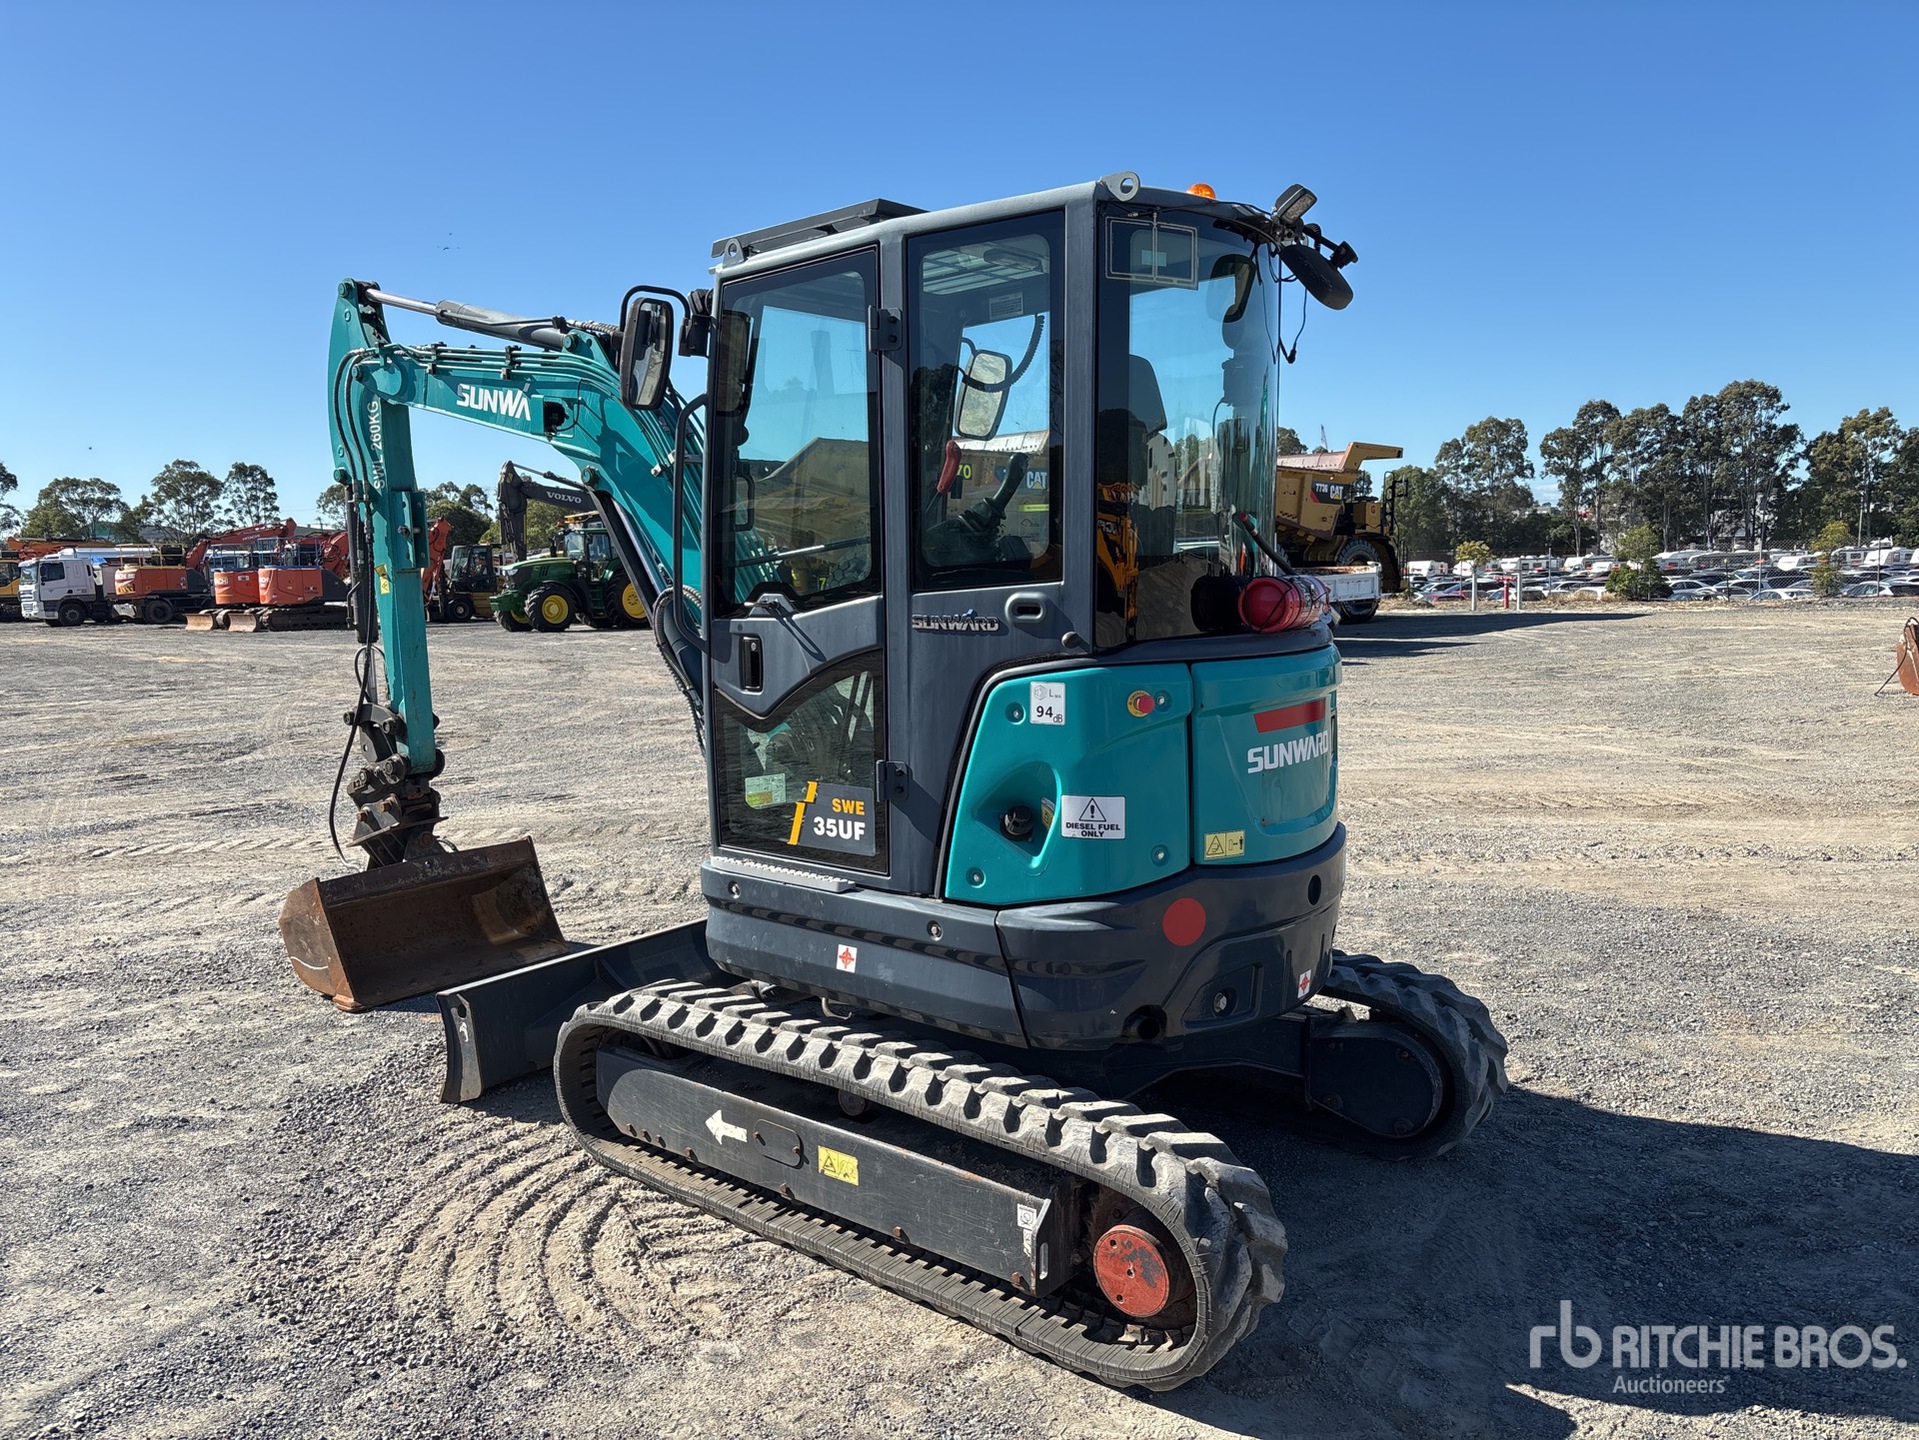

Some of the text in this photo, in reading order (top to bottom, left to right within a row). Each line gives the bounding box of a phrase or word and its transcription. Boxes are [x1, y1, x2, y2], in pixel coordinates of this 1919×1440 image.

[456, 381, 531, 421] SUNWA
[367, 400, 385, 489] SWL 260KG
[1026, 471, 1048, 490] CAT
[546, 491, 582, 504] VOLVO
[1329, 484, 1344, 500] CAT
[911, 608, 999, 632] SUNWARD
[1036, 705, 1063, 723] 94 dB
[1247, 729, 1330, 774] SUNWARD
[832, 798, 865, 816] SWE
[813, 816, 866, 841] 35UF
[1066, 821, 1121, 831] DIESEL FUEL
[1081, 830, 1105, 838] ONLY
